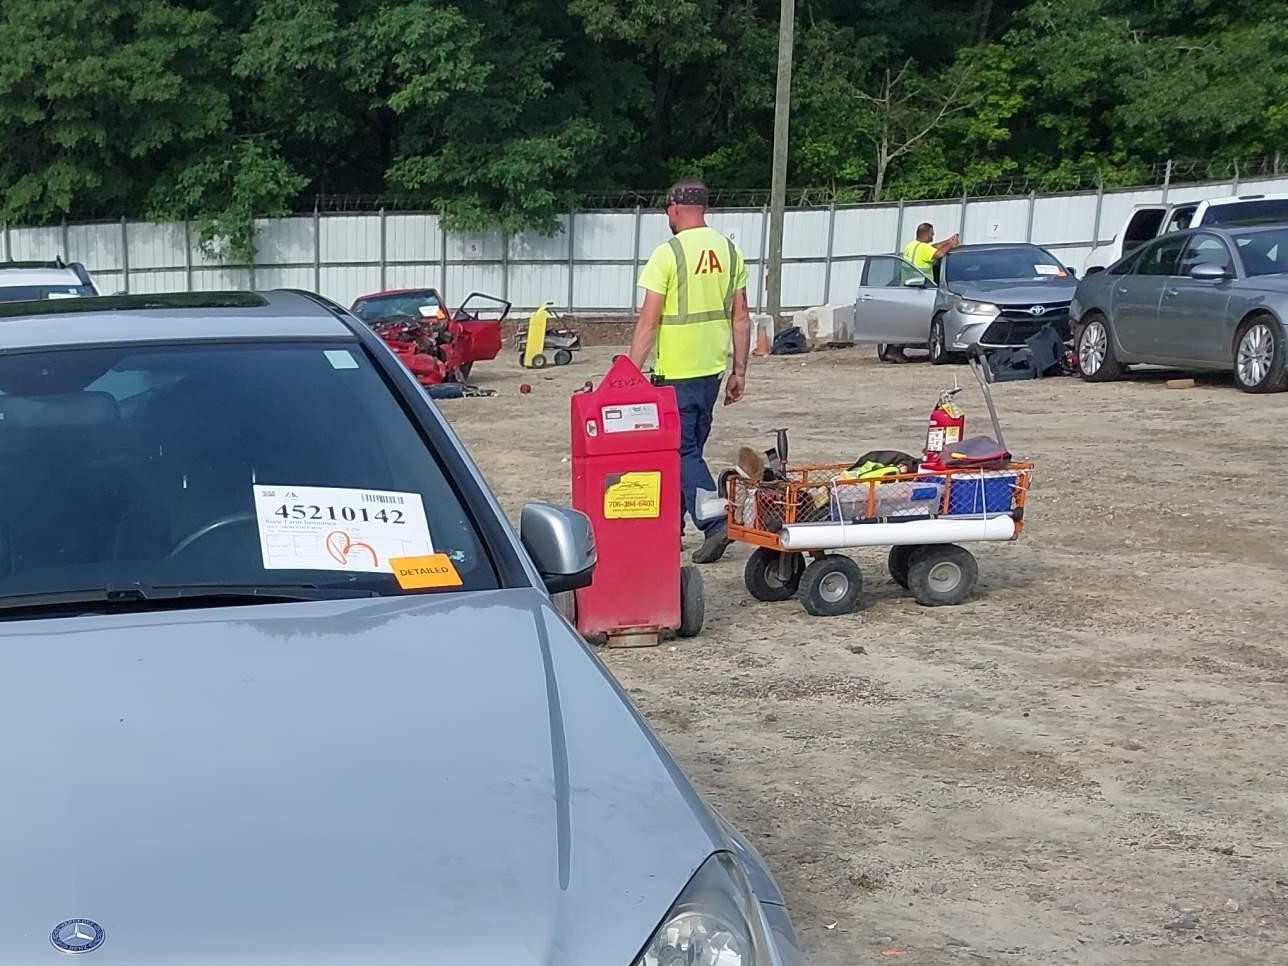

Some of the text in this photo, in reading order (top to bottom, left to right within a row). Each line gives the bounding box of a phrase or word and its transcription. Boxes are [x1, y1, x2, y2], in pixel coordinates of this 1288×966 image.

[610, 377, 645, 389] KEVIN
[274, 504, 406, 524] 45210142
[399, 567, 449, 576] DETAILED
